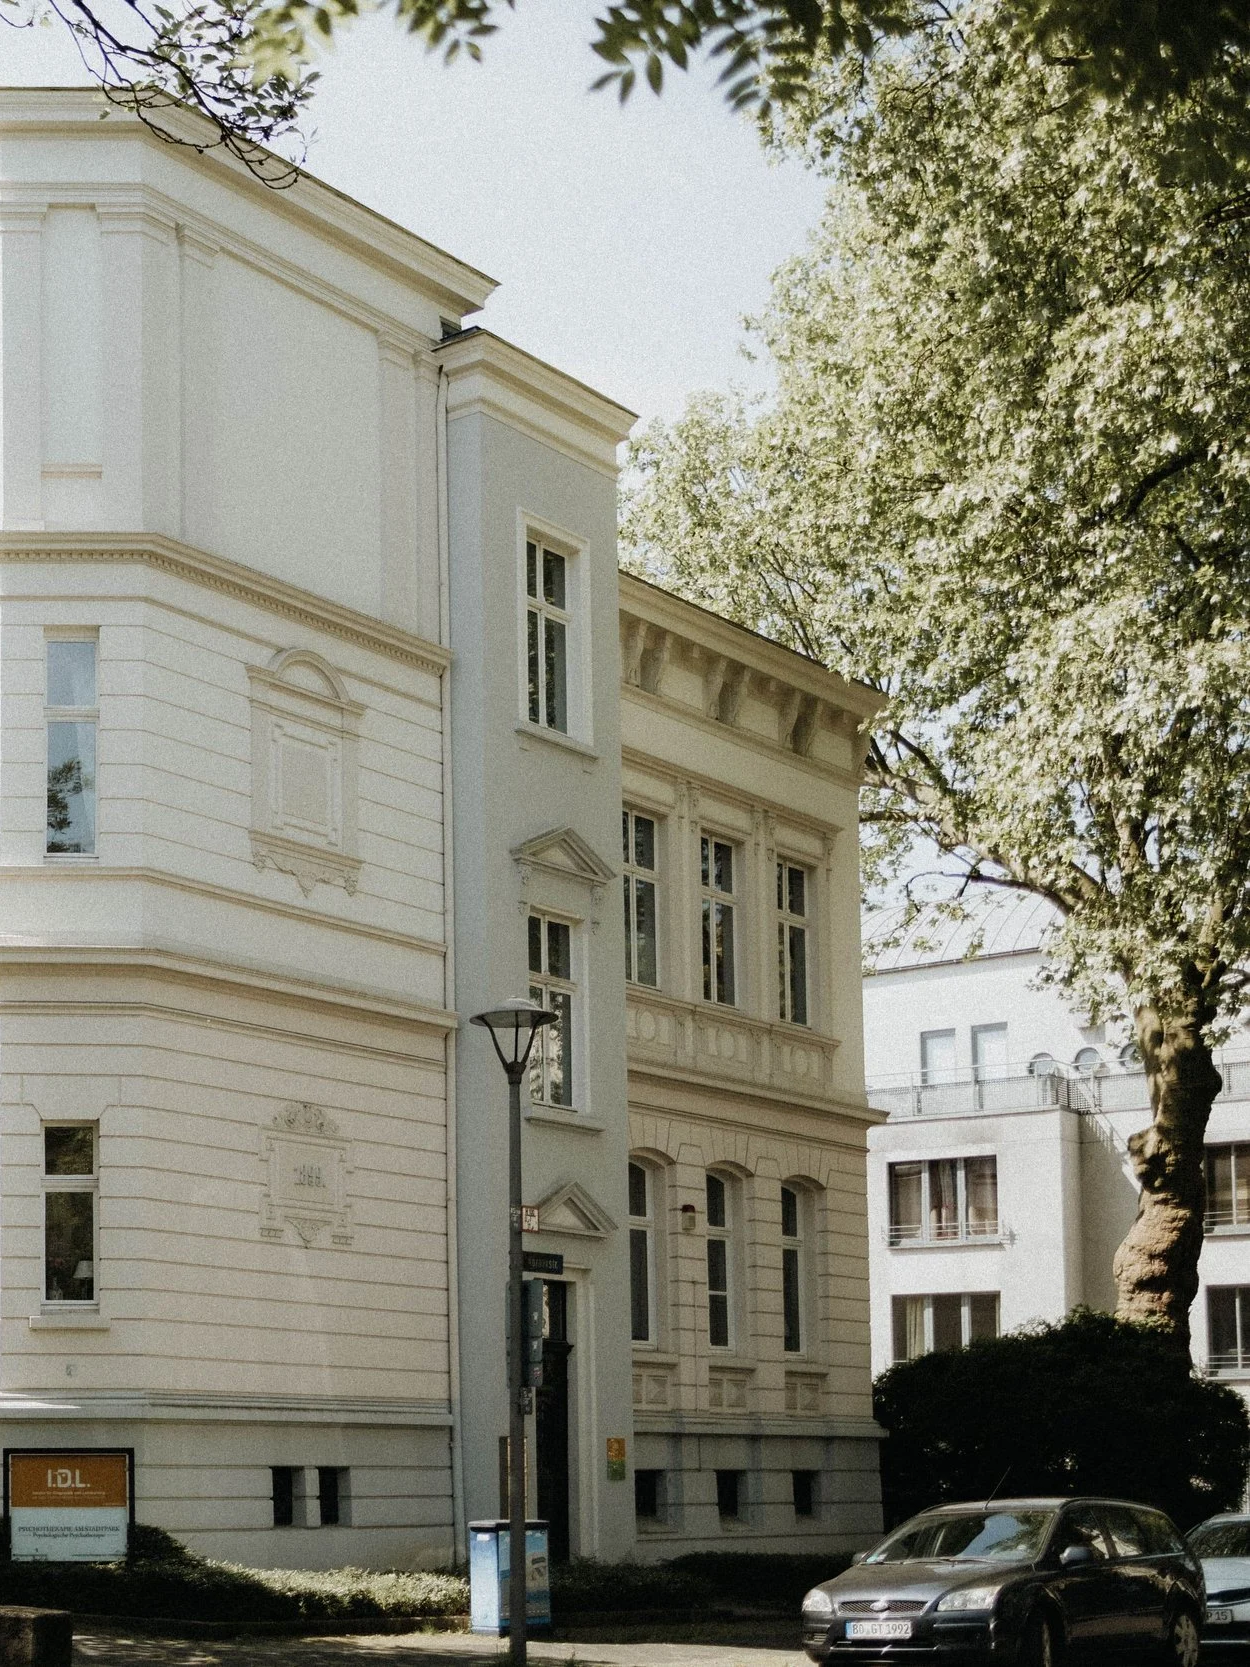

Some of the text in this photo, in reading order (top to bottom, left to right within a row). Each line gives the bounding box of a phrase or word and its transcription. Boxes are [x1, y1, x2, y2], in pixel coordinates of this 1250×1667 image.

[1215, 1611, 1228, 1620] 15
[871, 1624, 882, 1635] GT
[886, 1624, 910, 1635] 1992
